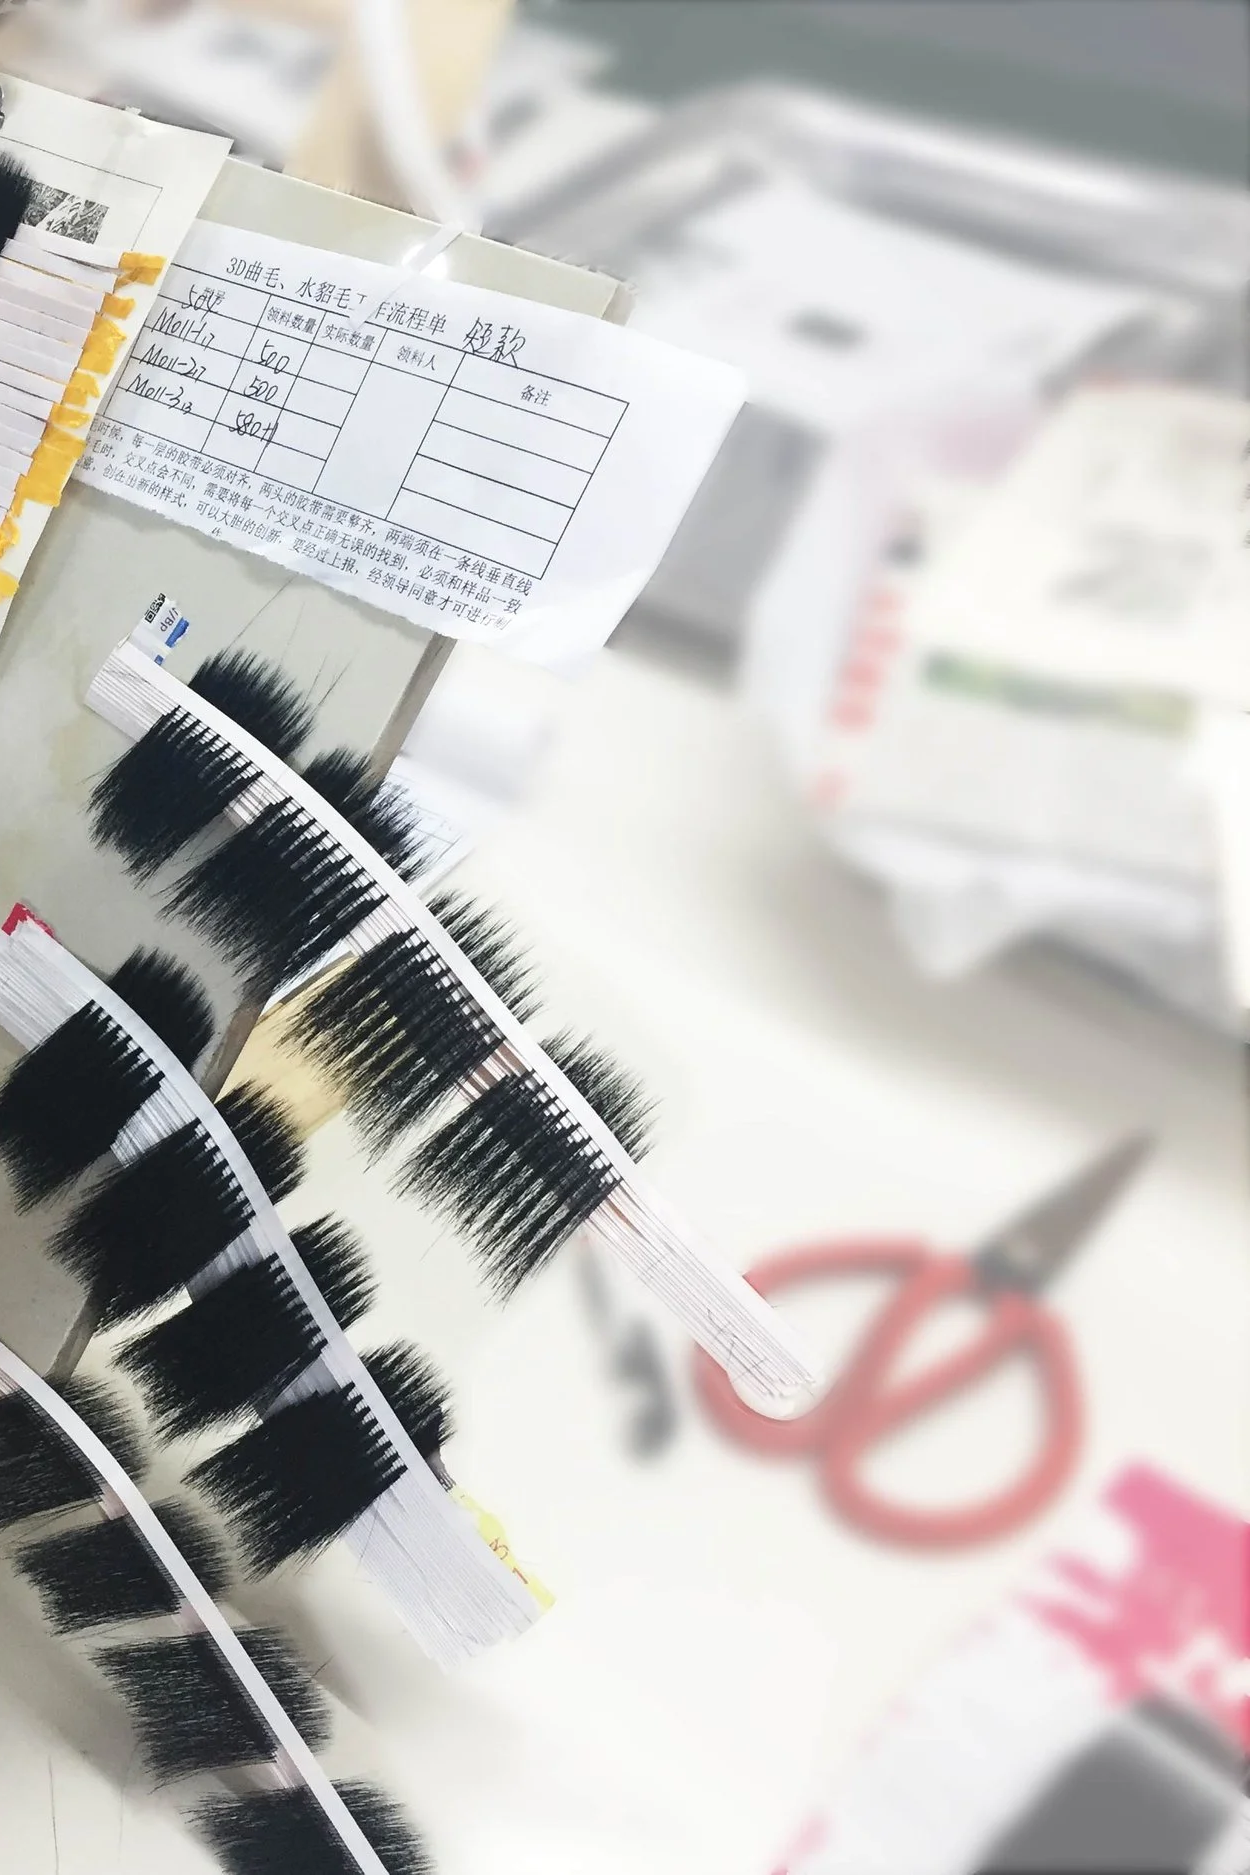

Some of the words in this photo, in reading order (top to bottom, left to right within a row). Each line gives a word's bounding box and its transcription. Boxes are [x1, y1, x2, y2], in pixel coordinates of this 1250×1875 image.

[266, 306, 317, 335] 领料数量
[321, 324, 376, 351] 实际数量
[257, 339, 290, 373] 500
[396, 345, 437, 371] 领料人
[243, 375, 278, 401] 500
[520, 384, 552, 407] 备注
